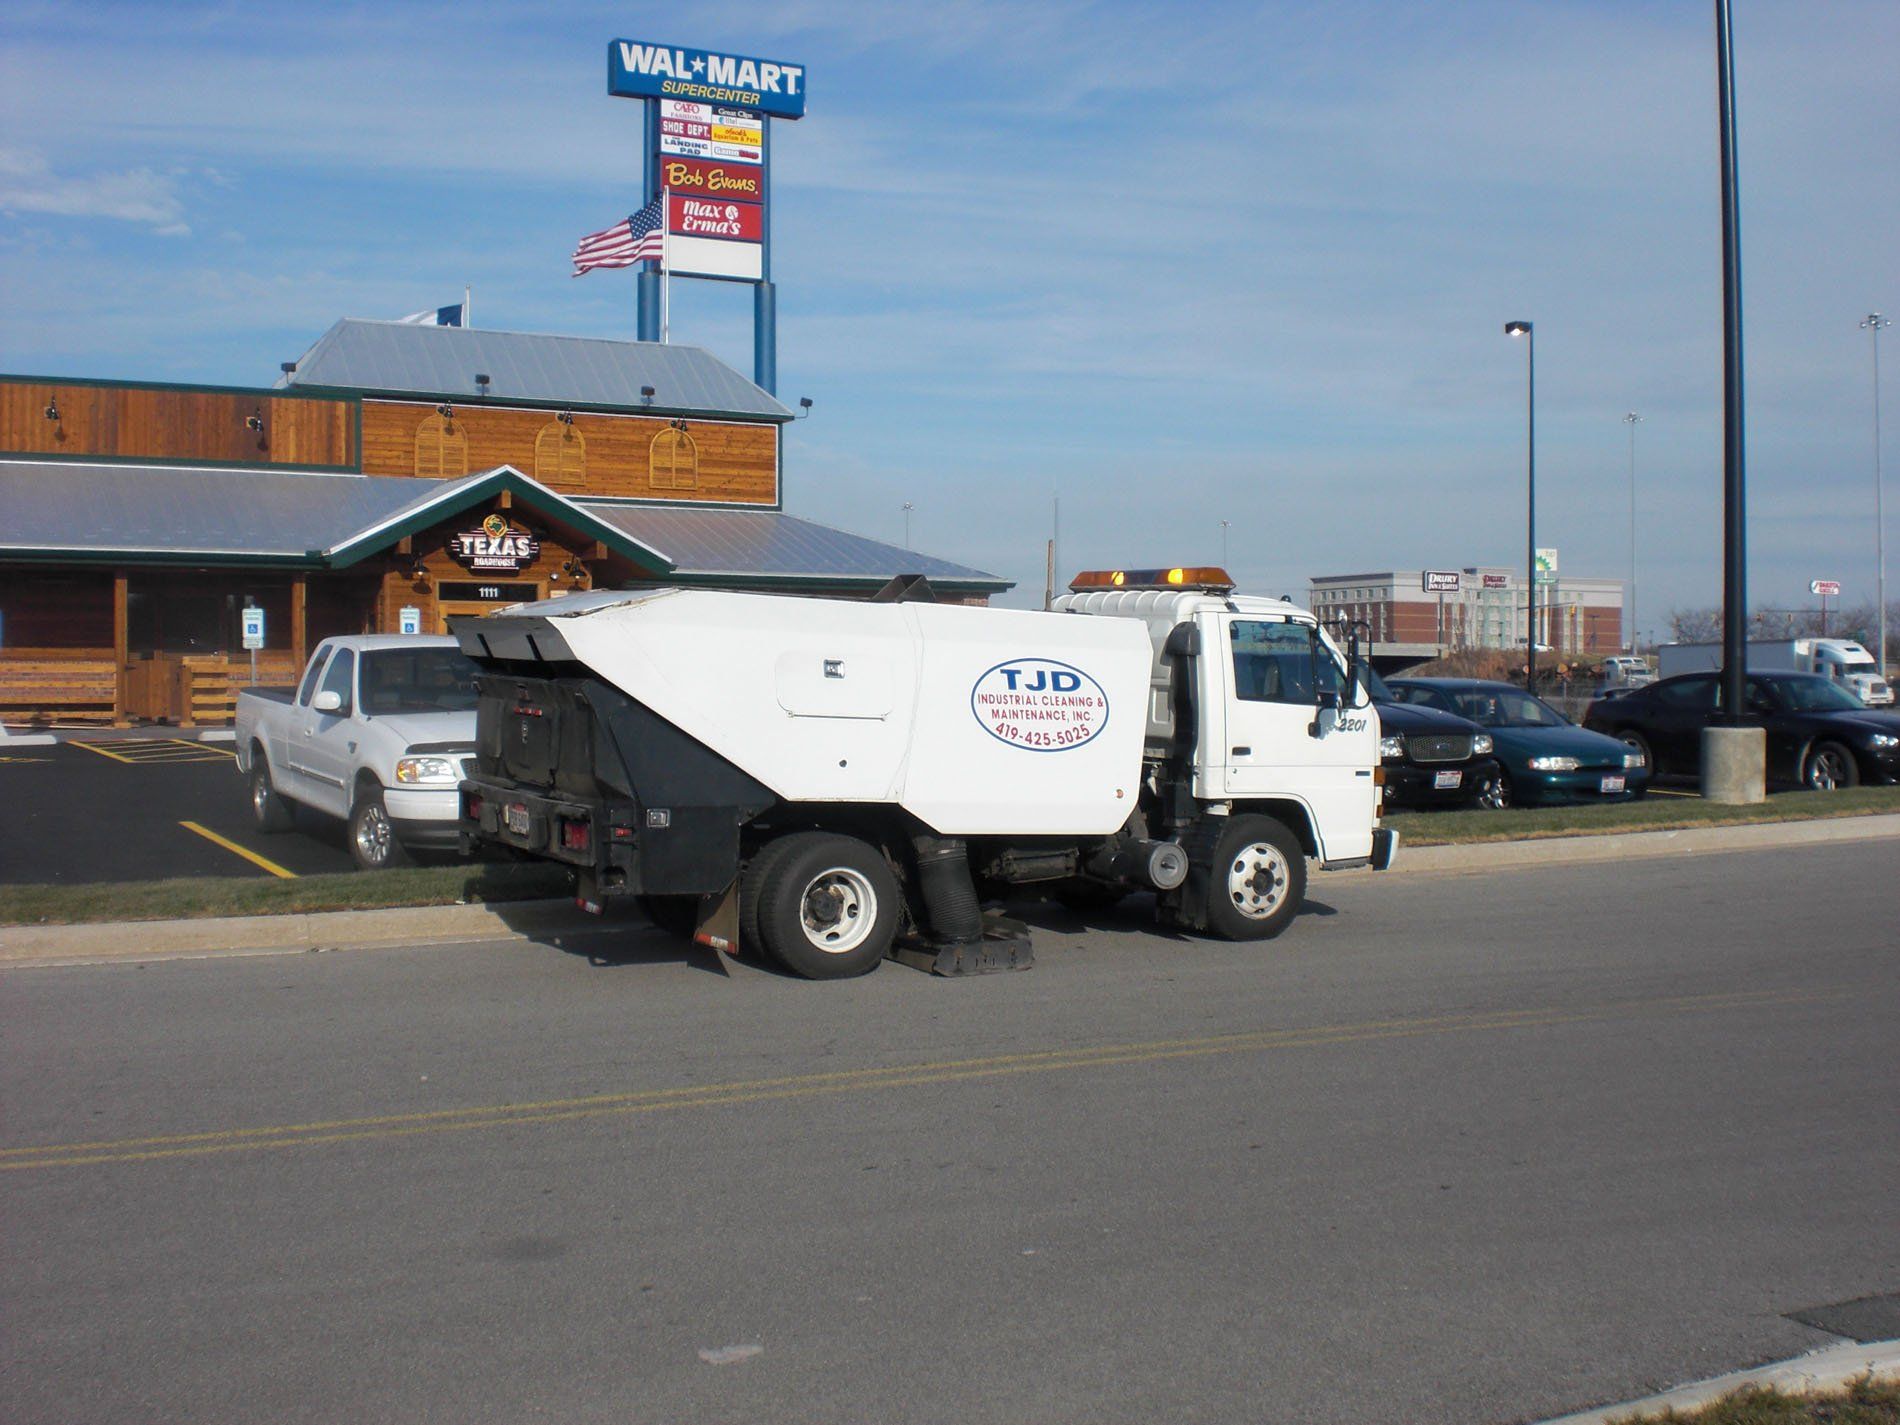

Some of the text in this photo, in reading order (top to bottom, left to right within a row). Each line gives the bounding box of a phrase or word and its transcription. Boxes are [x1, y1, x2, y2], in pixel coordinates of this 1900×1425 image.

[661, 81, 760, 105] SUPERCENTER
[673, 101, 700, 114] CATO
[662, 120, 710, 138] SHOE DEPT.
[664, 138, 708, 150] LANDING
[679, 147, 701, 155] PAD
[665, 162, 756, 192] Bob Evans
[682, 215, 741, 235] Erma's
[459, 536, 530, 556] TEXAS
[478, 587, 498, 598] 1111
[1000, 668, 1081, 692] TJD
[977, 693, 1104, 707] INDUSTRIAL CLEANING &
[991, 709, 1094, 722] MAINTENANCE, INC.
[1338, 717, 1367, 732] 2201
[995, 722, 1090, 746] 419-425-5025
